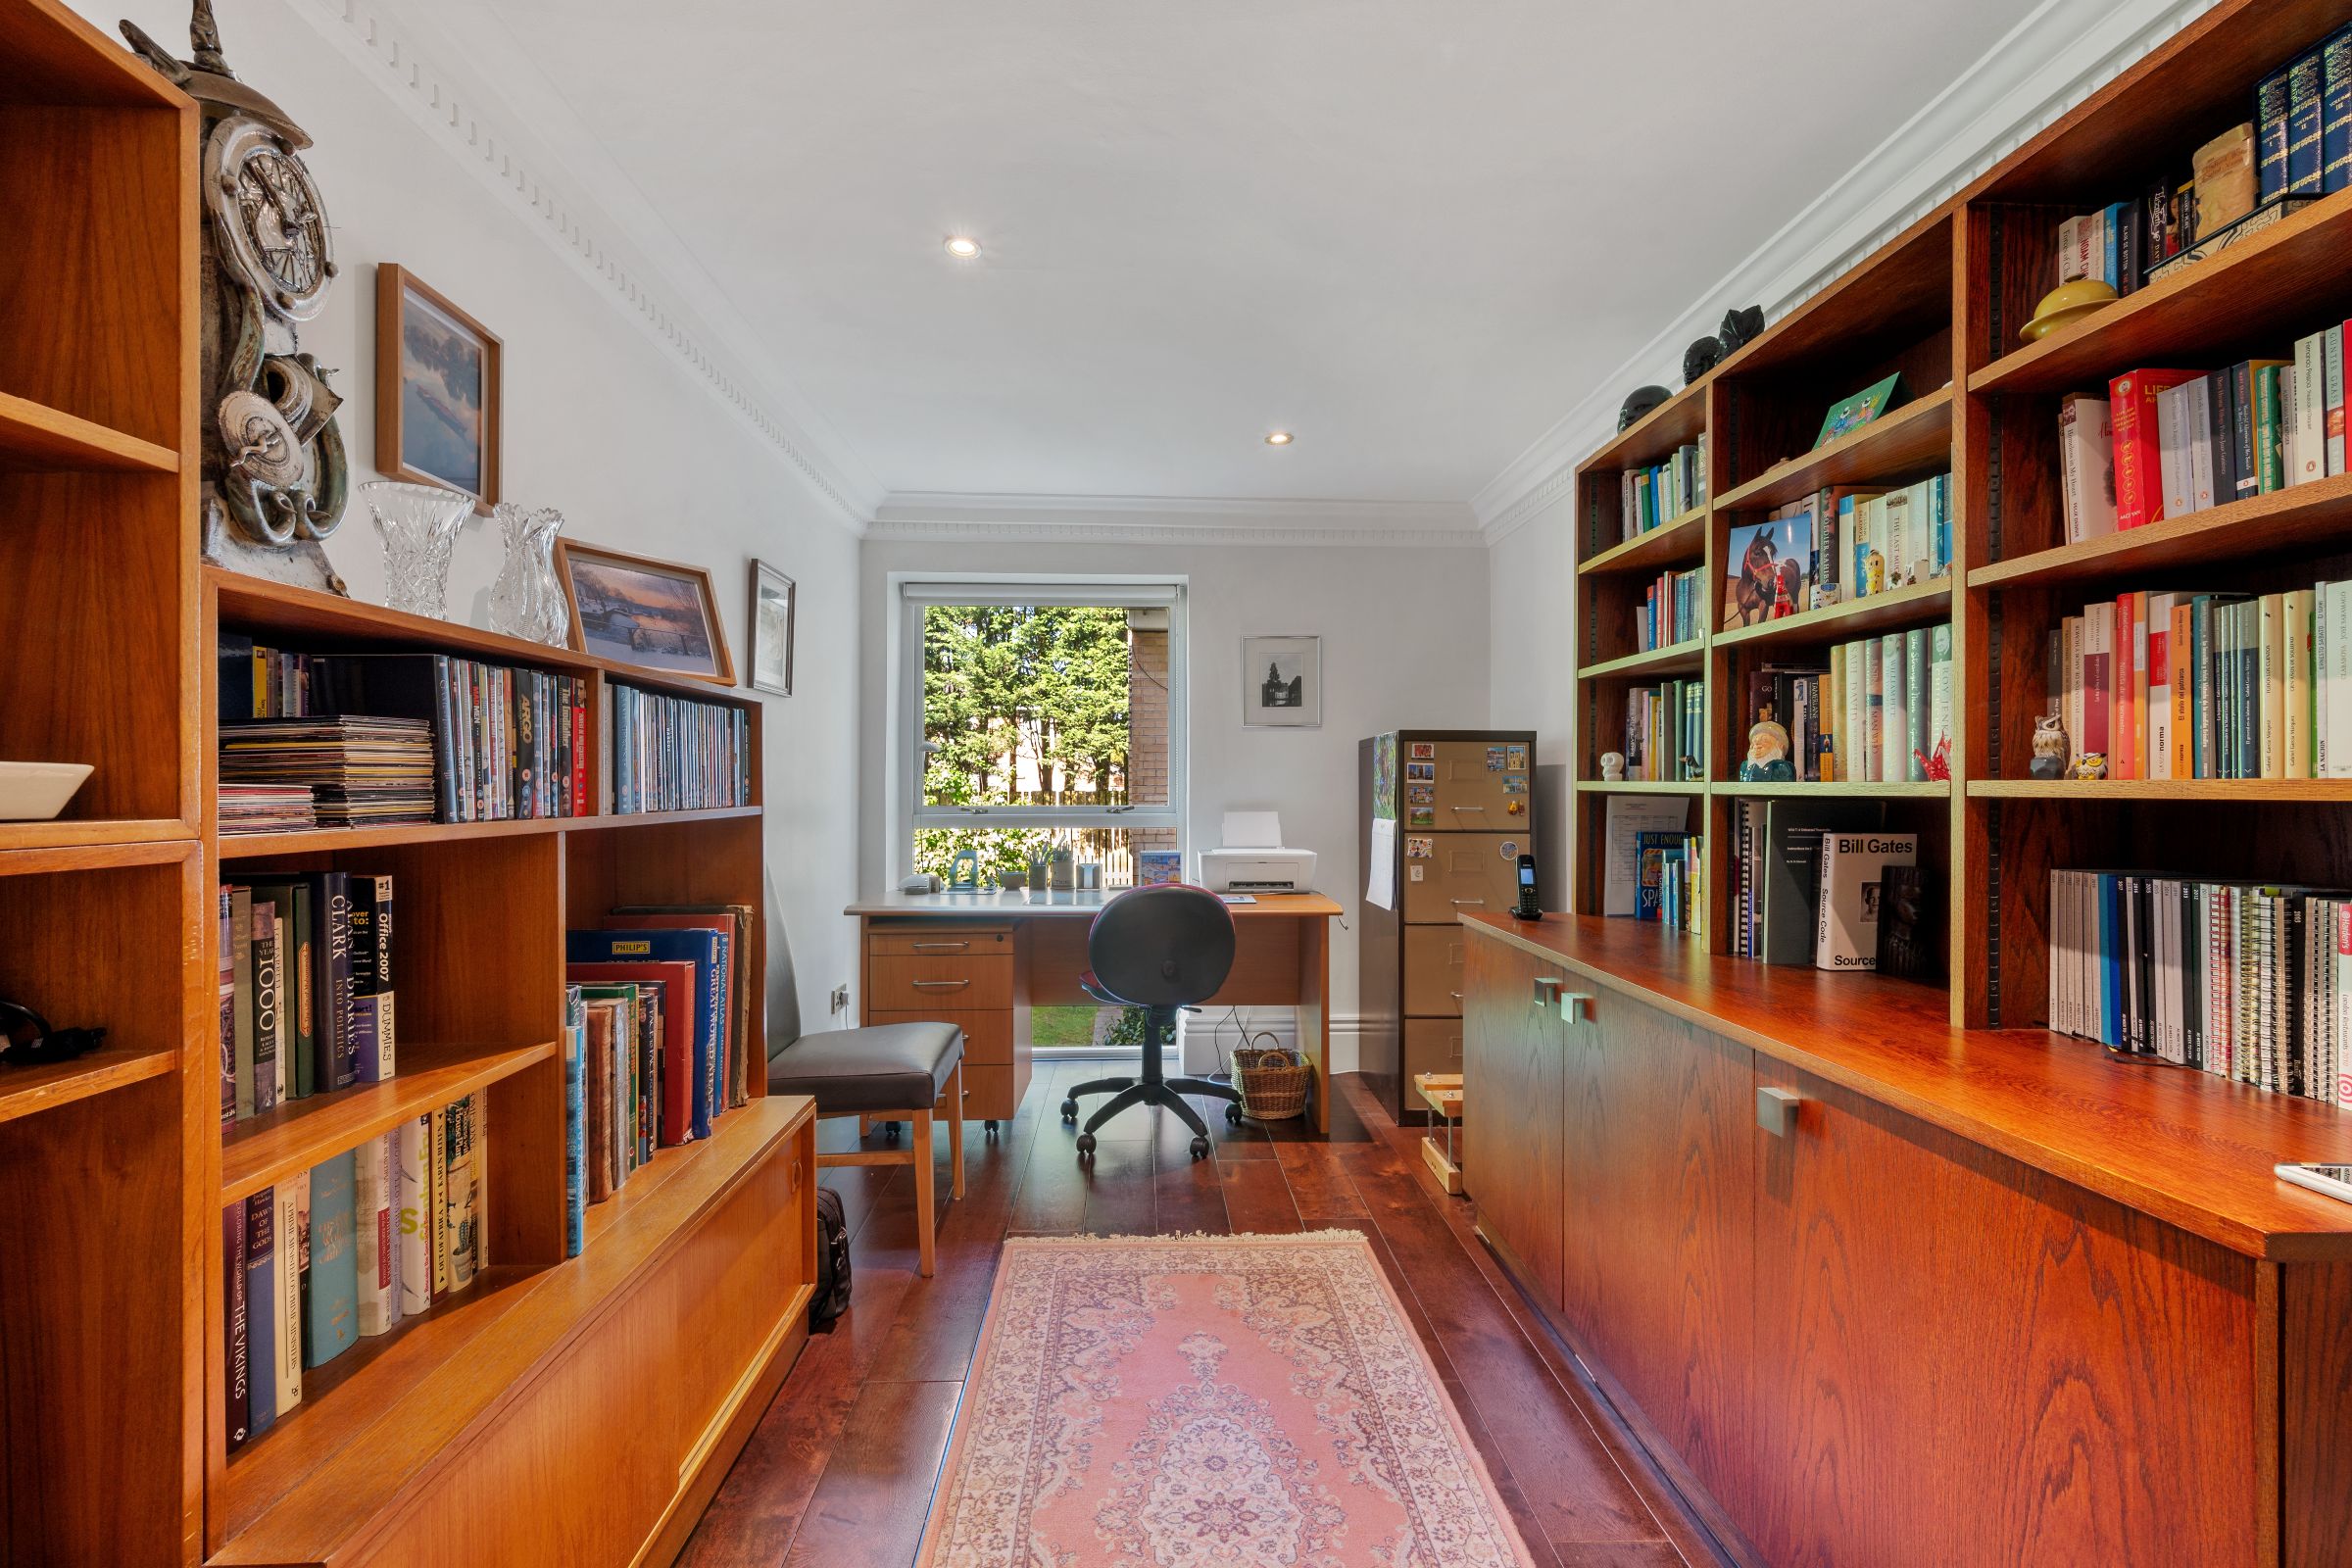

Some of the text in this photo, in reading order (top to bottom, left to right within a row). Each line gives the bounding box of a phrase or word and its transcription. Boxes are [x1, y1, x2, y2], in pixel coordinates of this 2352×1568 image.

[2081, 237, 2090, 263] NOAM
[2067, 428, 2076, 460] Homeless
[1849, 645, 1858, 675] SAUL
[519, 694, 533, 744] ARGO
[562, 687, 572, 749] The Godfather
[1871, 710, 1880, 732] MAN
[2320, 763, 2326, 772] LA
[1643, 833, 1658, 845] JUST
[1838, 839, 1913, 854] Bill Gates
[378, 880, 391, 891] #1
[331, 894, 347, 960] CLARK
[2341, 910, 2350, 951] @Harden's
[259, 948, 274, 956] YEAR
[261, 941, 274, 950] THE
[378, 912, 389, 982] Office 2007
[615, 944, 648, 953] PHILIP'S
[1835, 955, 1876, 966] Source
[259, 956, 275, 1032] 1000
[346, 976, 355, 1055] DIARIES
[336, 1009, 345, 1058] POLITICS
[382, 1003, 392, 1061] DUMMIES
[709, 1012, 717, 1060] WORLD
[455, 1107, 464, 1138] House
[418, 1131, 429, 1162] Fry
[251, 1205, 273, 1222] DAWN
[259, 1218, 269, 1227] OF
[252, 1236, 272, 1250] GODS
[256, 1226, 270, 1239] THE
[438, 1241, 445, 1253] OF
[235, 1261, 244, 1290] WORLD
[290, 1280, 296, 1294] ON
[235, 1290, 244, 1301] OF
[235, 1300, 245, 1335] THE
[235, 1335, 246, 1400] VIKINGS
